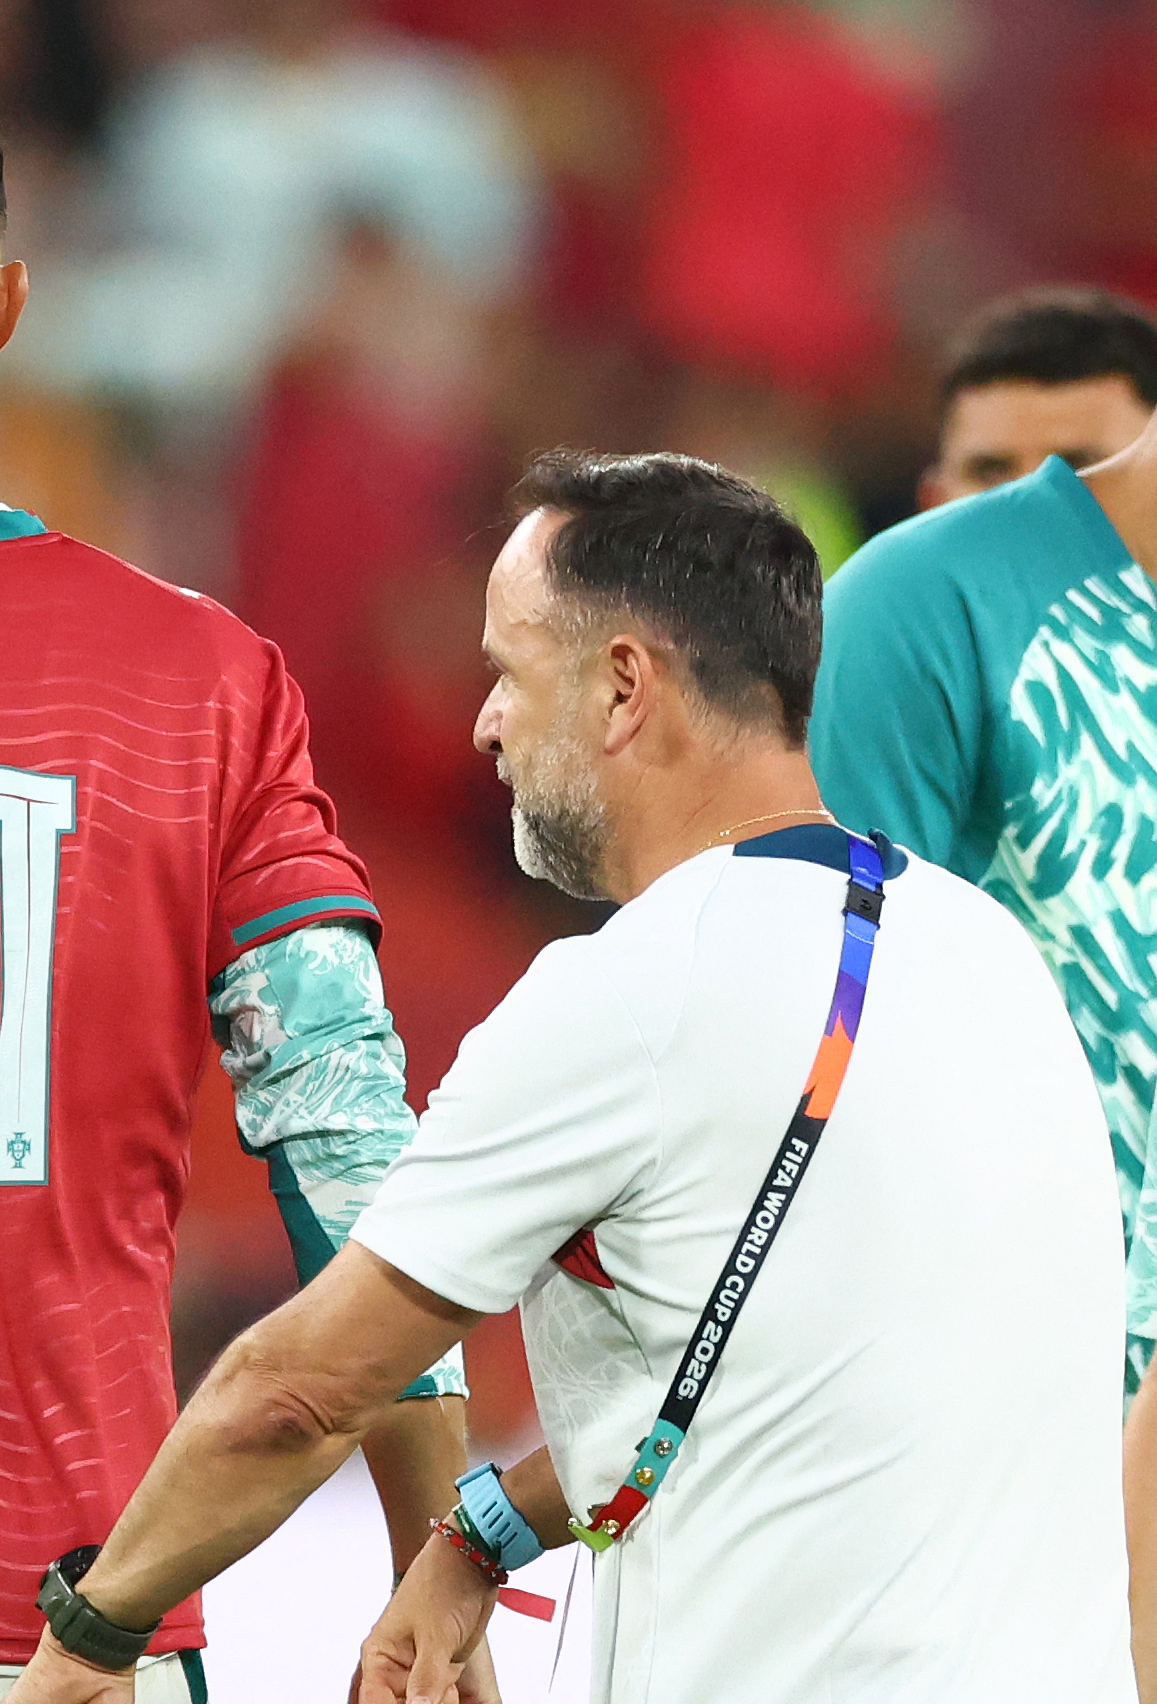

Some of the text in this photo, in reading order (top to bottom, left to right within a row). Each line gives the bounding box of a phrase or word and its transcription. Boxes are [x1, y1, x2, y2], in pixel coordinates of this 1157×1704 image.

[677, 1136, 809, 1400] FIFA WORLD CUP 2026
